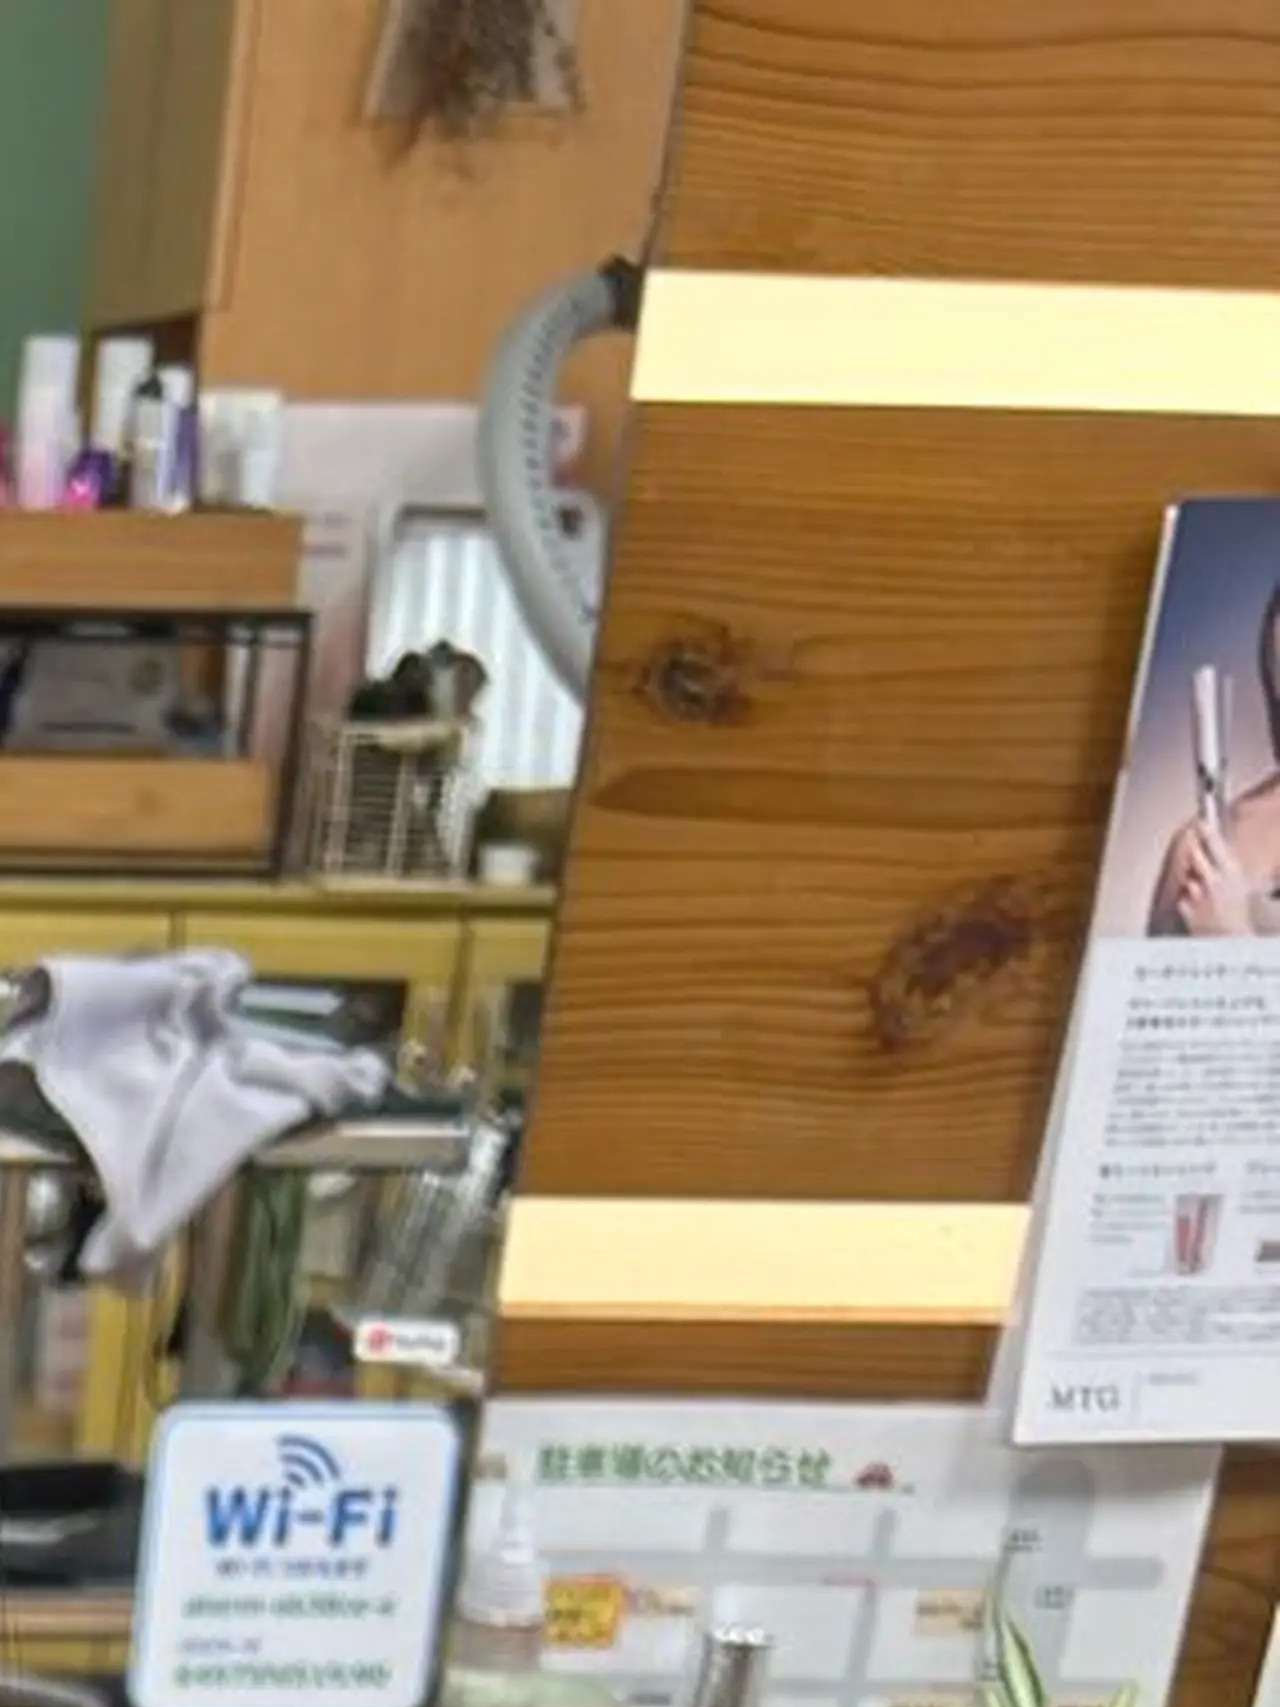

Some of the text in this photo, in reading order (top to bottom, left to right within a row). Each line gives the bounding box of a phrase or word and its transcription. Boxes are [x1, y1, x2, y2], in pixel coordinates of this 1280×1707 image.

[1046, 1384, 1121, 1413] MTG
[538, 1443, 832, 1487] 駐車場のお知らせ
[206, 1484, 397, 1548] Wi-Fi
